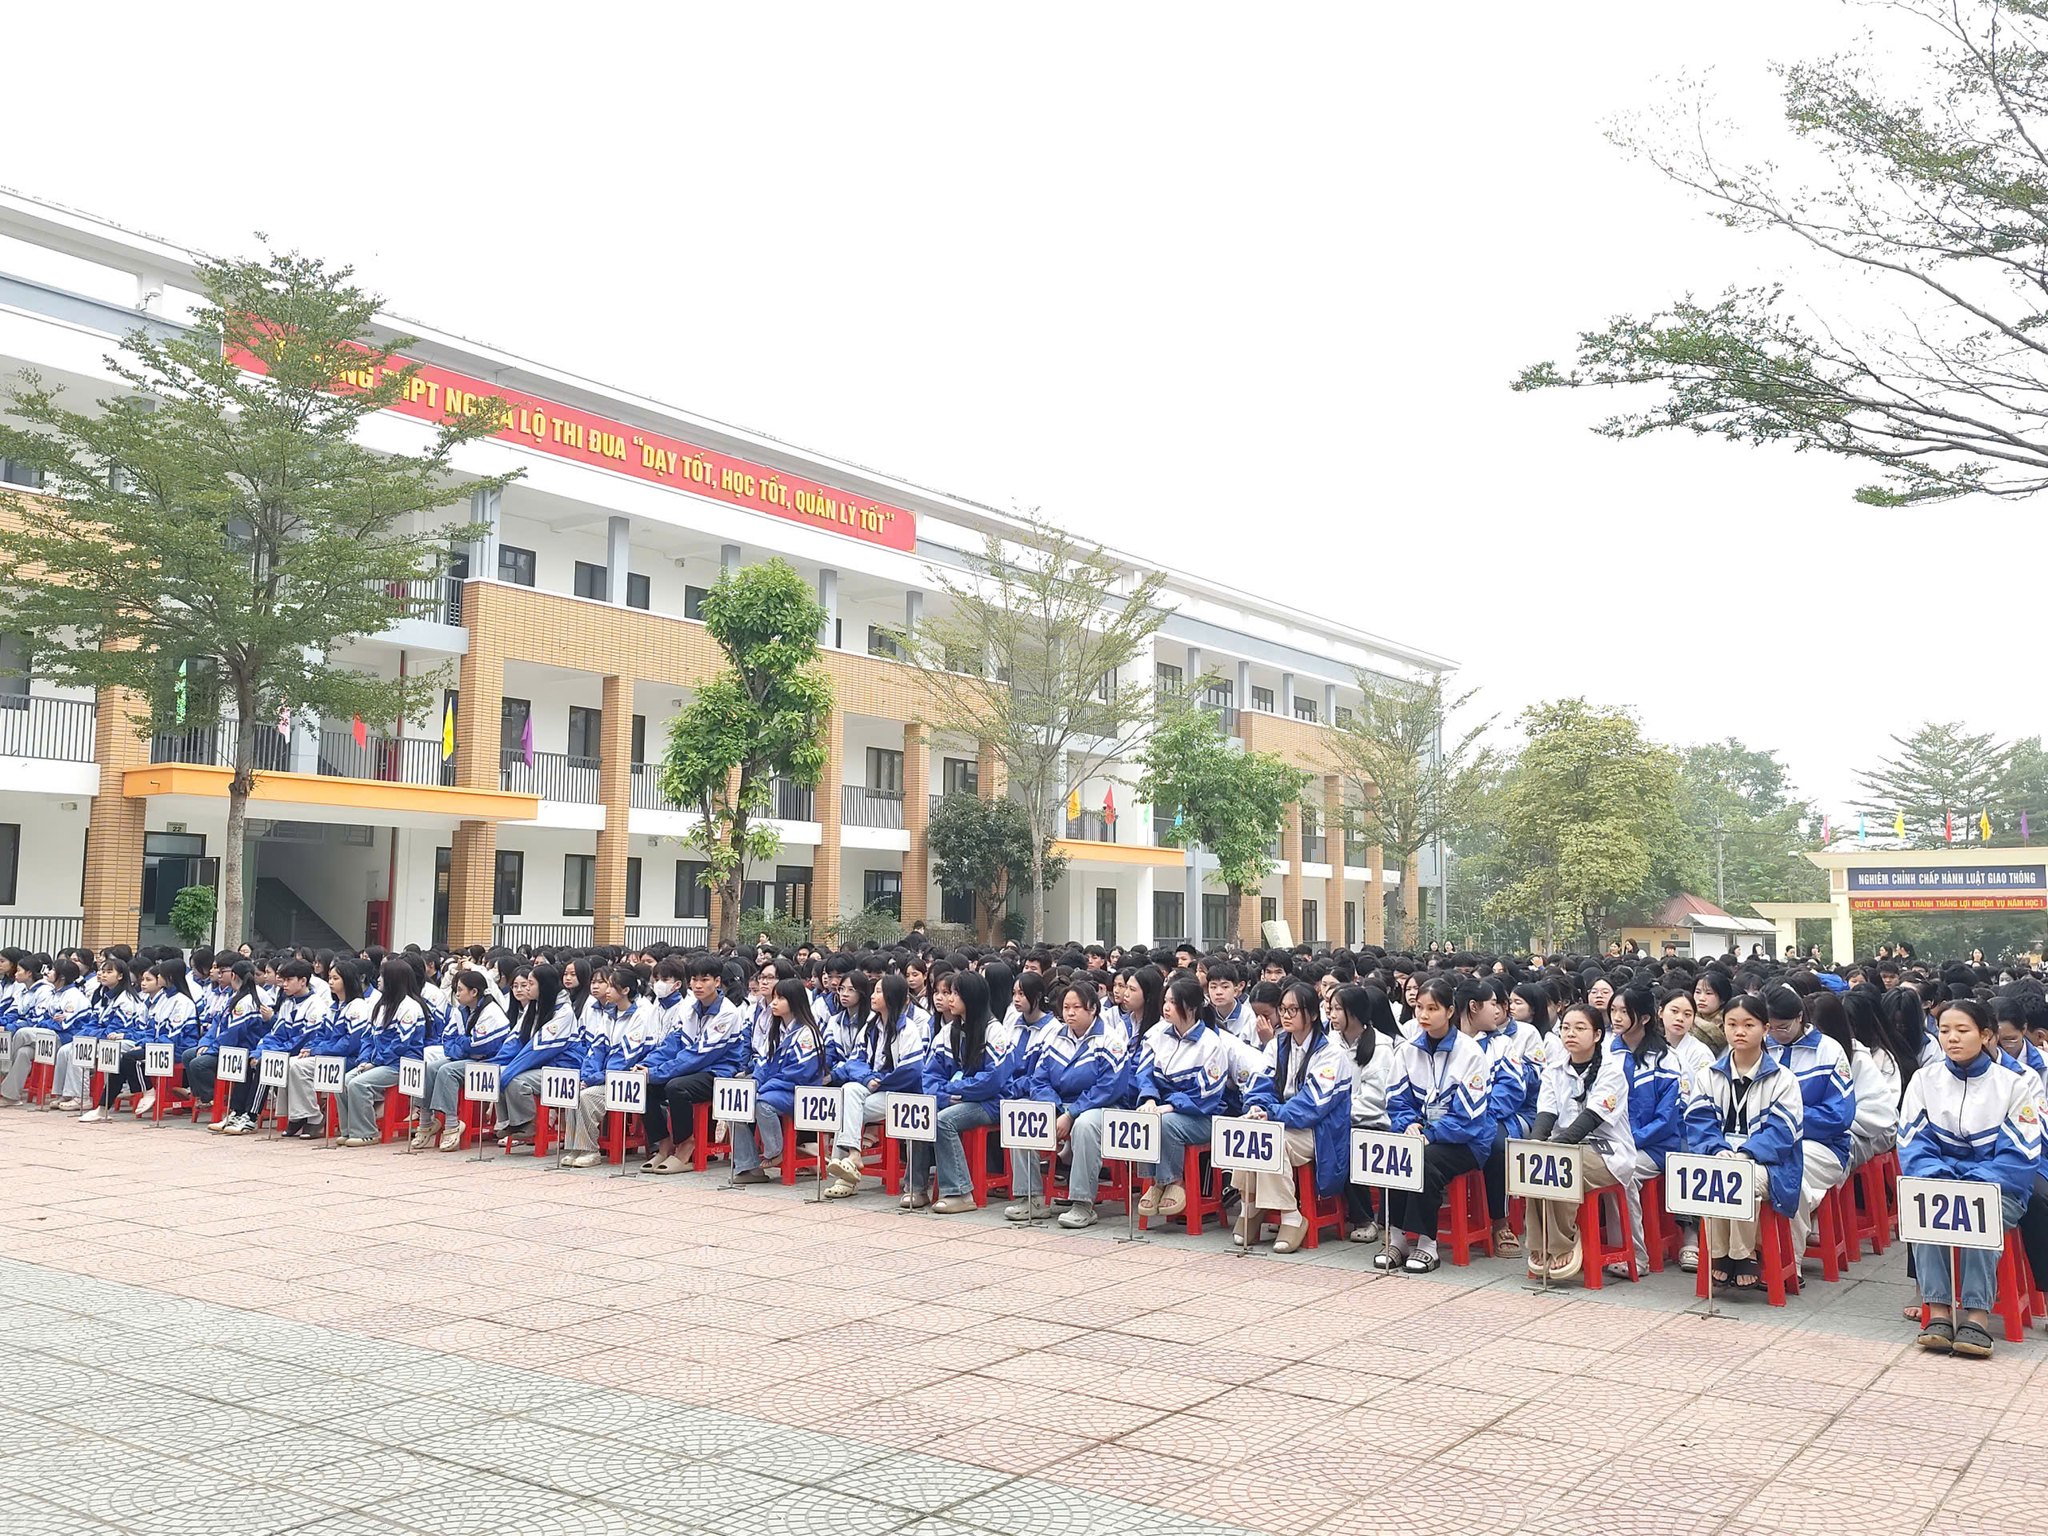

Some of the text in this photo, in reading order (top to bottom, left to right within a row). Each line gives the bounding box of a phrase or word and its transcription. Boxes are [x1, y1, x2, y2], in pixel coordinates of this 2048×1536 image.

[519, 407, 547, 443] LỘ
[551, 417, 583, 448] THI
[587, 428, 626, 461] ĐUA
[681, 452, 717, 489] TỐT,
[721, 467, 755, 498] HỌC
[759, 475, 791, 510] TỐT,
[795, 488, 836, 520] QUẢN
[839, 501, 856, 526] LÝ
[1858, 871, 1889, 885] NGHIÊM
[1918, 870, 1939, 885] CHẤP
[1941, 870, 1964, 885] HÀNH
[1966, 870, 1985, 886] LUẬT
[1987, 872, 2007, 884] GIAO
[37, 1039, 54, 1058] 10A3
[75, 1043, 93, 1061] 10A2
[101, 1047, 117, 1066] 10A1
[149, 1050, 170, 1069] 11C5
[222, 1054, 243, 1074] 11C4
[264, 1058, 284, 1079] 11C3
[318, 1062, 340, 1085] 11C2
[402, 1067, 421, 1089] 11C1
[469, 1070, 495, 1093] 11A4
[547, 1076, 576, 1100] 11A3
[610, 1080, 640, 1104] 11A2
[719, 1087, 749, 1113] 11A1
[801, 1096, 837, 1122] 12C4
[892, 1103, 930, 1130] 12C3
[1007, 1111, 1049, 1139] 12C2
[1108, 1120, 1150, 1151] 12C1
[1222, 1129, 1273, 1161] 12A5
[1358, 1142, 1413, 1178] 12A4
[1515, 1152, 1574, 1188] 12A3
[1676, 1167, 1743, 1206] 12A2
[1913, 1192, 1987, 1234] 12A1
